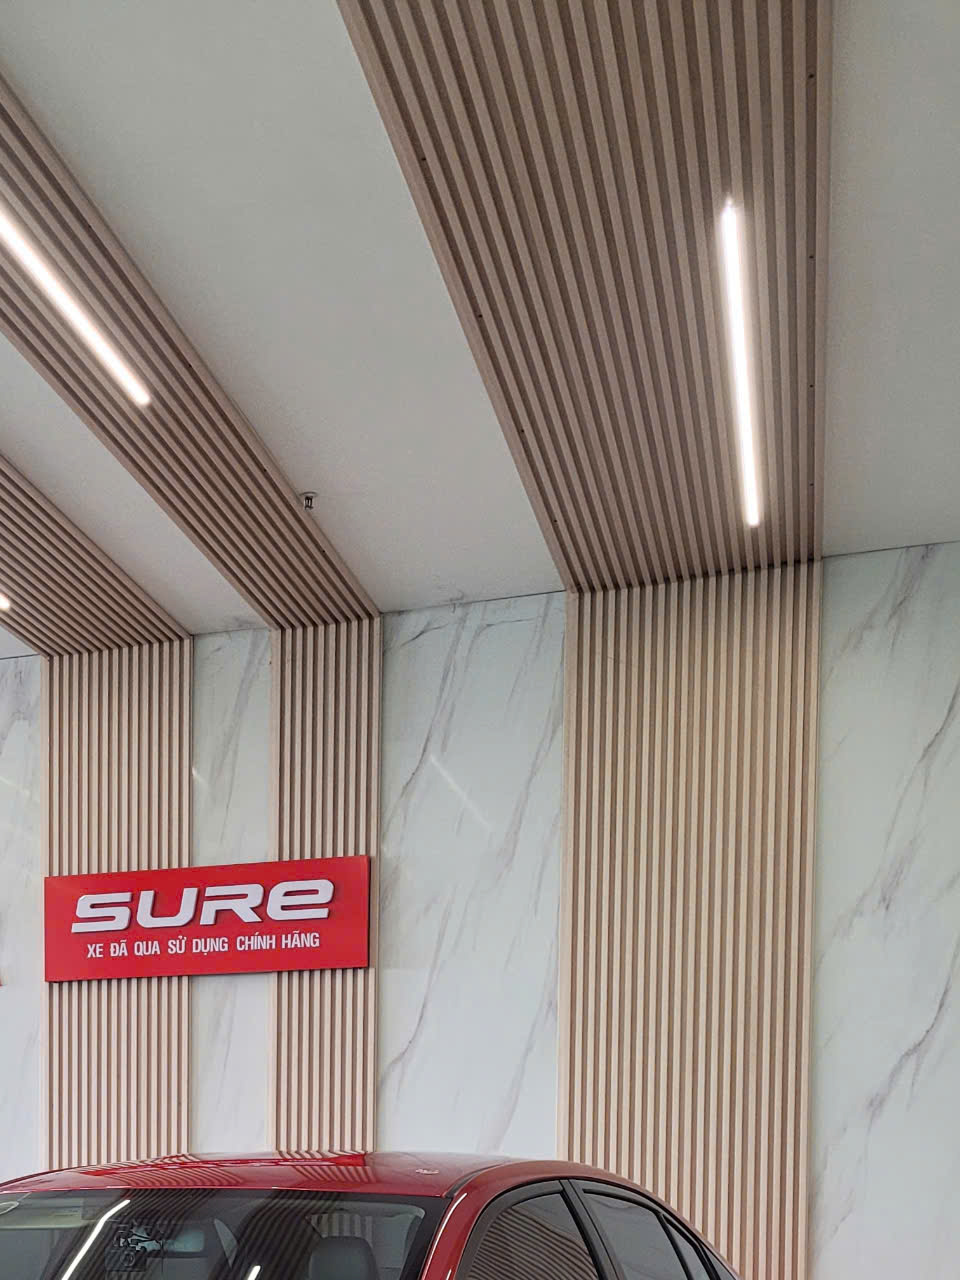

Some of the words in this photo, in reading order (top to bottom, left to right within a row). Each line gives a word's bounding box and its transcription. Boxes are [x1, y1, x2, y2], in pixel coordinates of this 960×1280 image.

[87, 943, 104, 958] XE
[110, 939, 128, 957] ĐÃ
[134, 940, 161, 956] QUA
[167, 935, 187, 954] SỬ
[192, 937, 229, 956] DỤNG
[236, 931, 276, 951] CHÍNH
[281, 930, 320, 949] HÃNG
